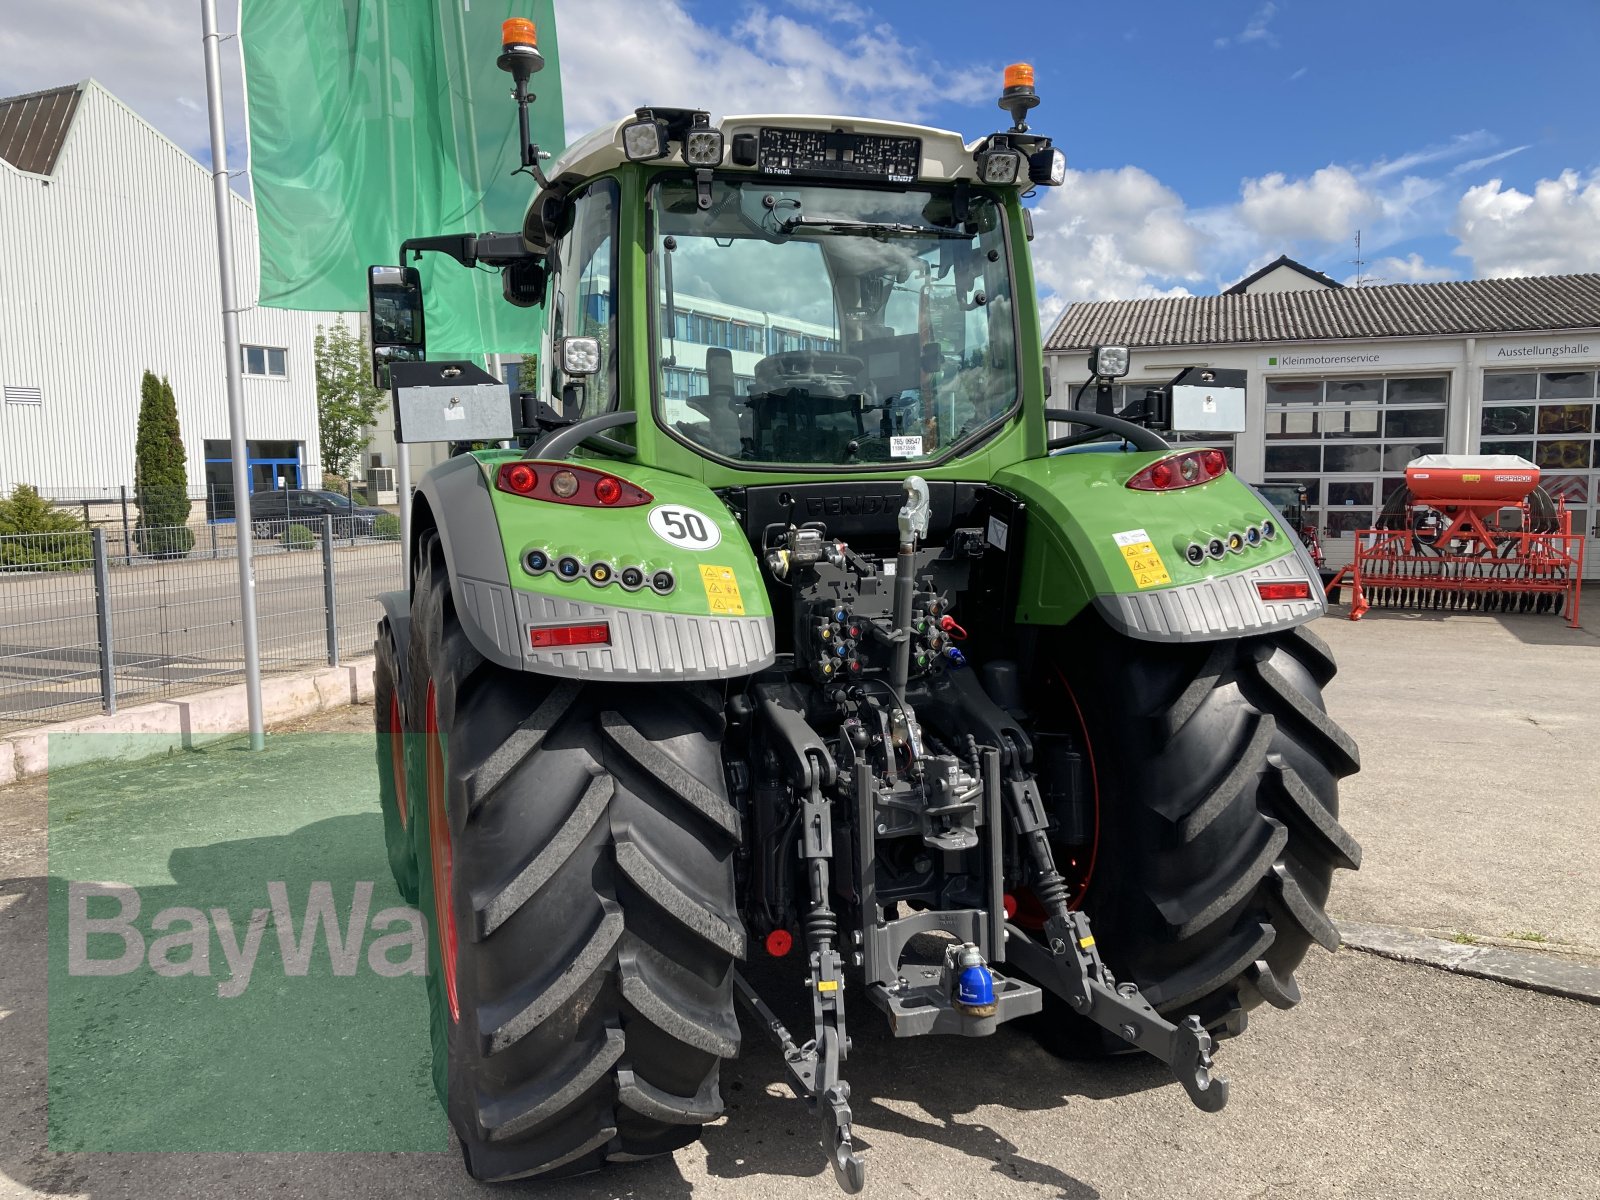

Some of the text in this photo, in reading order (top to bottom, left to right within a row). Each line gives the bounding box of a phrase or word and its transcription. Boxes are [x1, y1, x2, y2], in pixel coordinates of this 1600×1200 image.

[1497, 343, 1590, 357] Ausstellungshalle
[1282, 353, 1380, 366] Kleinmotorenservice
[806, 495, 902, 517] FENDT
[661, 510, 709, 542] 50
